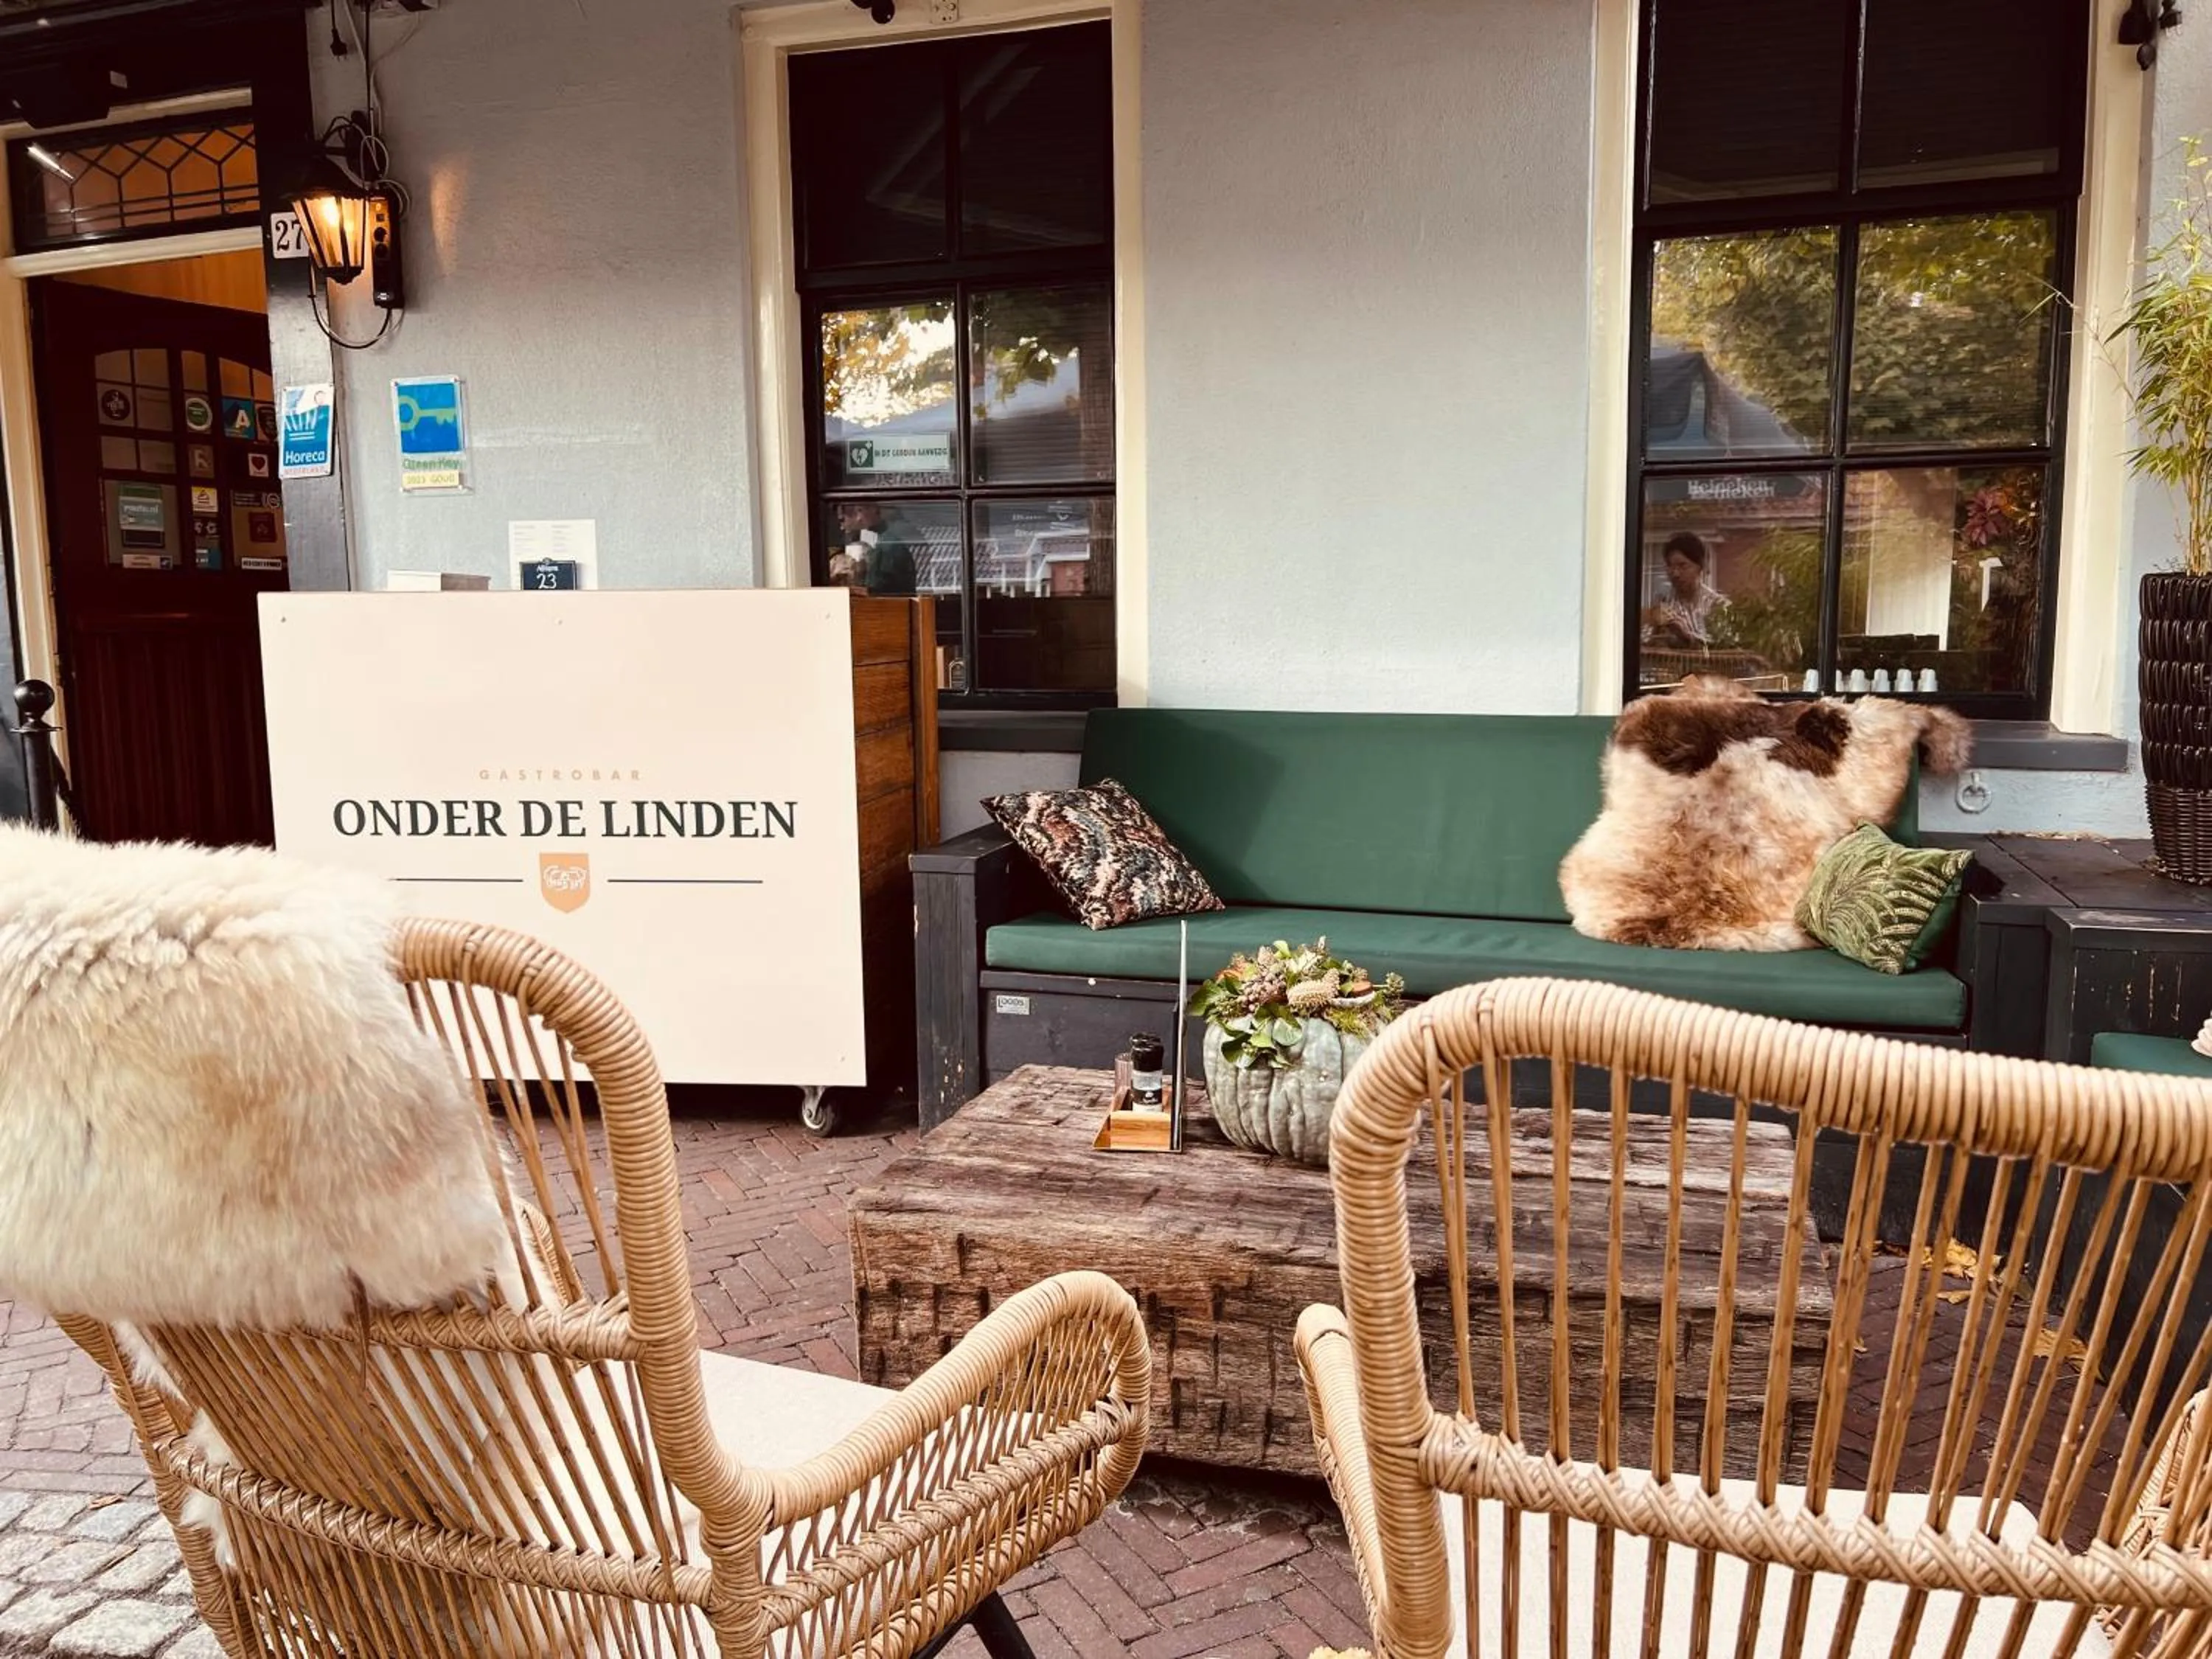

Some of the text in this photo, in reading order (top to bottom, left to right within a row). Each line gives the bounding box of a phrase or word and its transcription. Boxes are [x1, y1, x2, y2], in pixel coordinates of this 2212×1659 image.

[275, 219, 302, 251] 27
[285, 451, 325, 464] Horeca
[537, 573, 557, 589] 23
[479, 769, 639, 781] GASTROBAR
[333, 799, 798, 838] ONDER DE LINDEN
